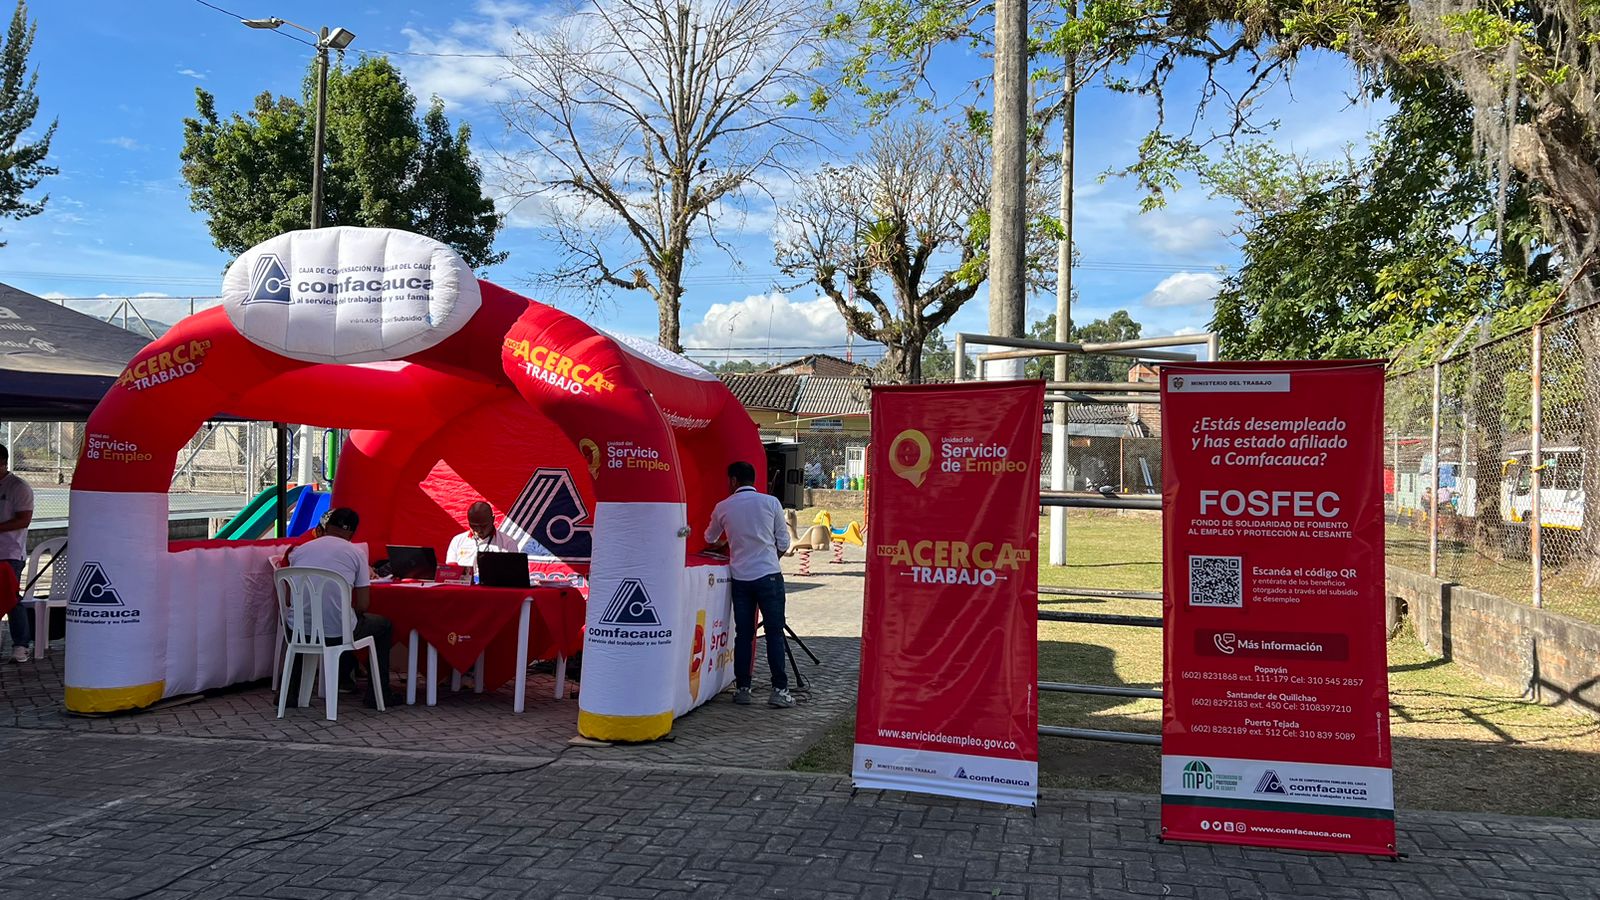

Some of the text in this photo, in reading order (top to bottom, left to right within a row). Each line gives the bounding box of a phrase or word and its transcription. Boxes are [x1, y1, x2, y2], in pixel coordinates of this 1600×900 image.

[327, 265, 371, 275] COPENSACIÓN
[297, 276, 434, 294] comfacauca
[121, 340, 205, 387] ACERCA
[513, 339, 604, 392] ACERCA
[134, 362, 195, 390] TRABAJO
[526, 362, 582, 394] TRABAJO
[1192, 416, 1346, 433] ¿Estás desempleado
[88, 438, 137, 451] Servicio
[1191, 434, 1347, 450] y has estado afiliado
[87, 449, 152, 463] de Empleo
[607, 446, 658, 459] Servicio
[941, 443, 1007, 458] Servicio
[607, 457, 670, 471] de Empleo
[941, 457, 1027, 475] de Empleo
[1211, 452, 1327, 467] a Comfacauca?
[1200, 489, 1340, 518] FOSFEC
[1191, 519, 1220, 527] FONDO
[1222, 519, 1233, 527] DE
[1235, 520, 1292, 528] SOLIDARIDAD
[1307, 521, 1348, 529] FOMENTO
[1201, 528, 1234, 536] EMPLEO
[1243, 527, 1297, 537] PROTECCIÓN
[1312, 530, 1352, 538] CESANTE
[878, 539, 1026, 570] NOS ACERCA AL
[911, 567, 996, 586] TRABAJO
[1294, 567, 1303, 576] el
[1305, 568, 1338, 579] código
[1340, 568, 1357, 578] QR
[1258, 577, 1287, 585] entérate
[1310, 579, 1345, 587] beneficios
[1252, 586, 1287, 595] otorgados
[1294, 587, 1316, 595] través
[1329, 588, 1358, 596] subsidio
[1262, 595, 1300, 604] desempleo
[589, 627, 672, 638] comfacauca
[1237, 639, 1322, 652] Más información
[1254, 665, 1287, 675] Popayán
[1181, 671, 1201, 680] (602)
[1202, 672, 1237, 681] 8231868
[1239, 674, 1254, 682] ext.
[1290, 675, 1305, 684] Cel:
[1307, 676, 1322, 685] 310
[1325, 677, 1340, 685] 545
[1342, 678, 1363, 686] 2857
[1226, 690, 1317, 702] Santander de Quilichao
[1191, 698, 1351, 713] (602) 8292183 ext. 450 Cel: 3108397210
[1244, 719, 1300, 729] Puerto Tejada
[877, 728, 1015, 750] www.serviciodeempleo.gov.co
[1191, 724, 1211, 733] (602)
[1212, 726, 1247, 735] 8282189
[1249, 728, 1264, 736] ext.
[1282, 729, 1298, 737] Cel:
[1299, 730, 1315, 738] 310
[1317, 731, 1332, 740] 839
[1335, 732, 1355, 741] 5089
[969, 774, 1030, 787] comfacauca
[1183, 772, 1212, 789] MPC
[1289, 784, 1367, 795] comfacauca
[1250, 825, 1351, 839] www.comfacauca.com
